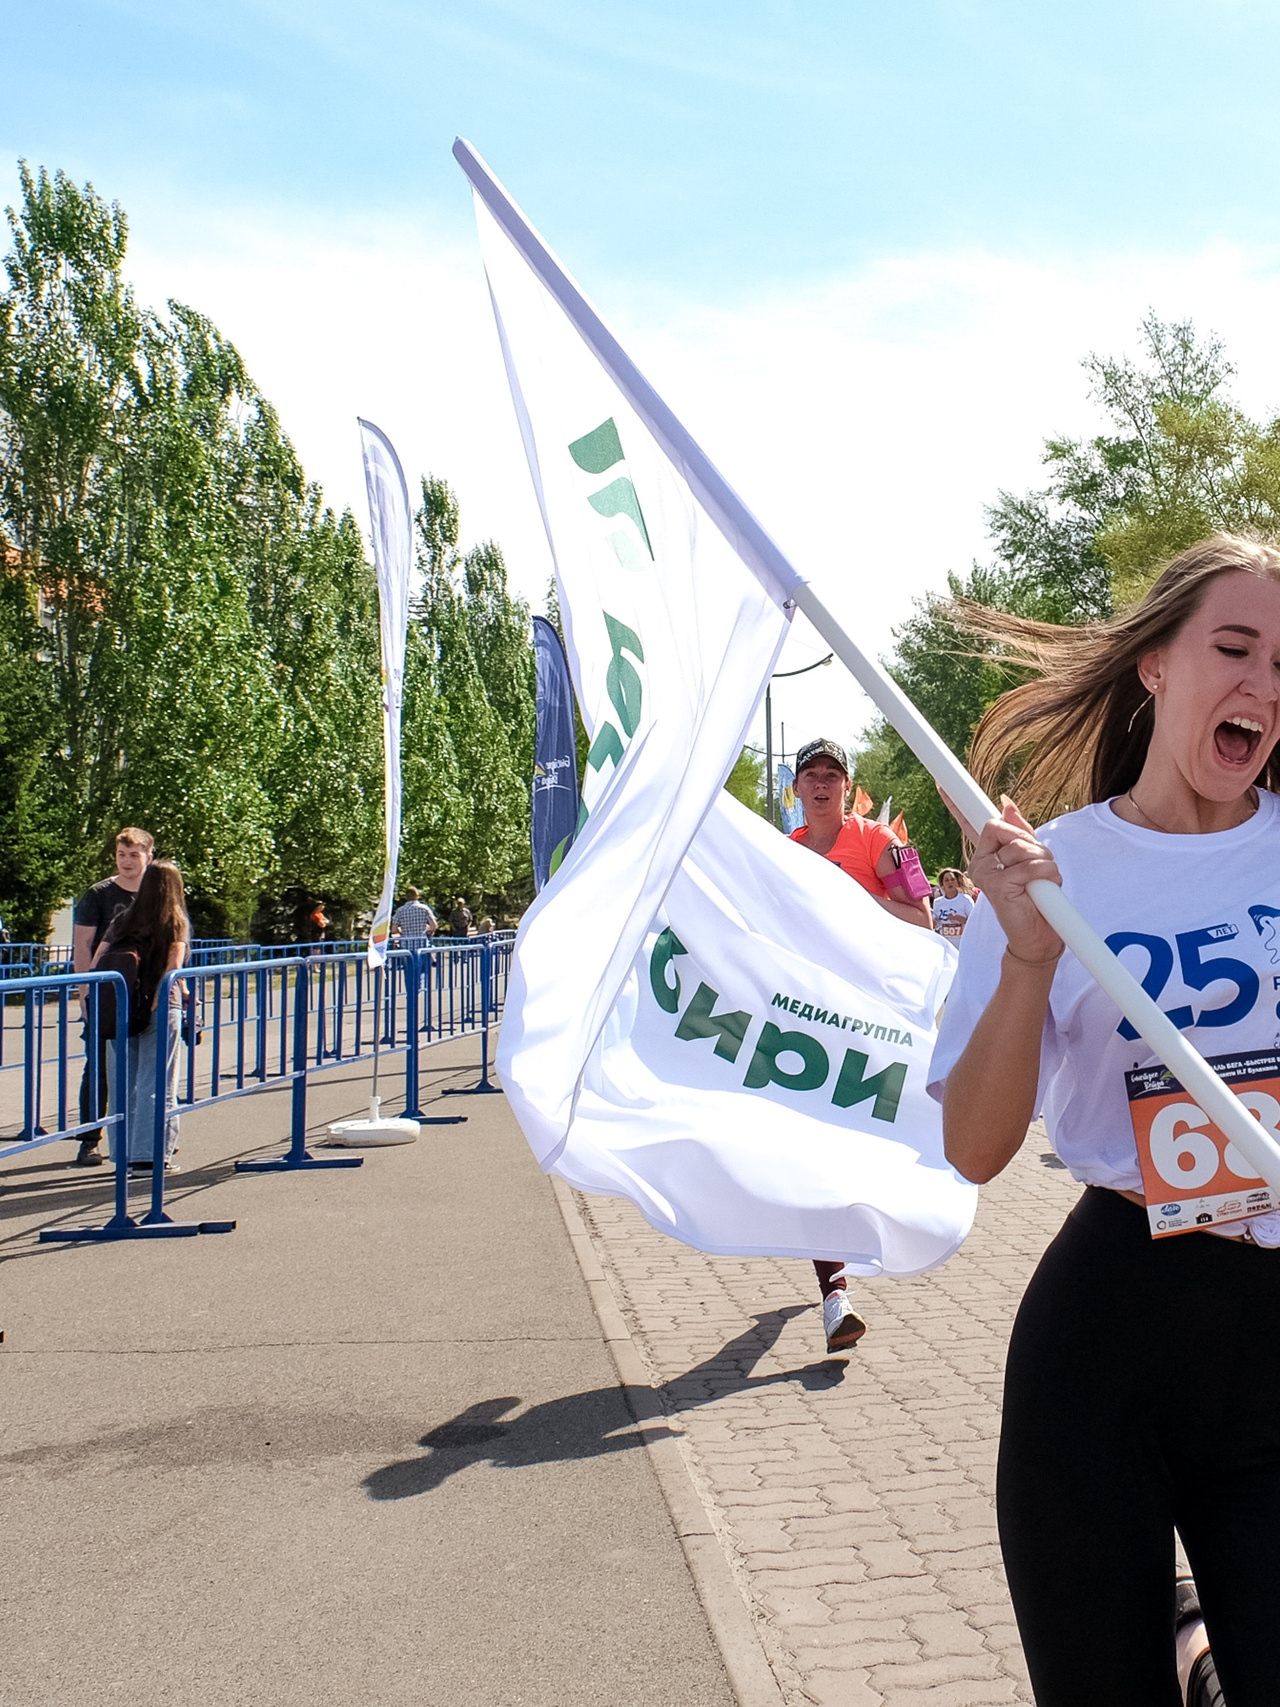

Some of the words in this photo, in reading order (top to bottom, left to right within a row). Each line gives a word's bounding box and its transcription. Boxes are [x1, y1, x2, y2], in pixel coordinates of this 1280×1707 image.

[943, 926, 962, 935] 507
[1216, 926, 1233, 936] ЛЕТ
[1104, 923, 1259, 1041] 25
[770, 992, 914, 1047] МЕДИАГРУППА
